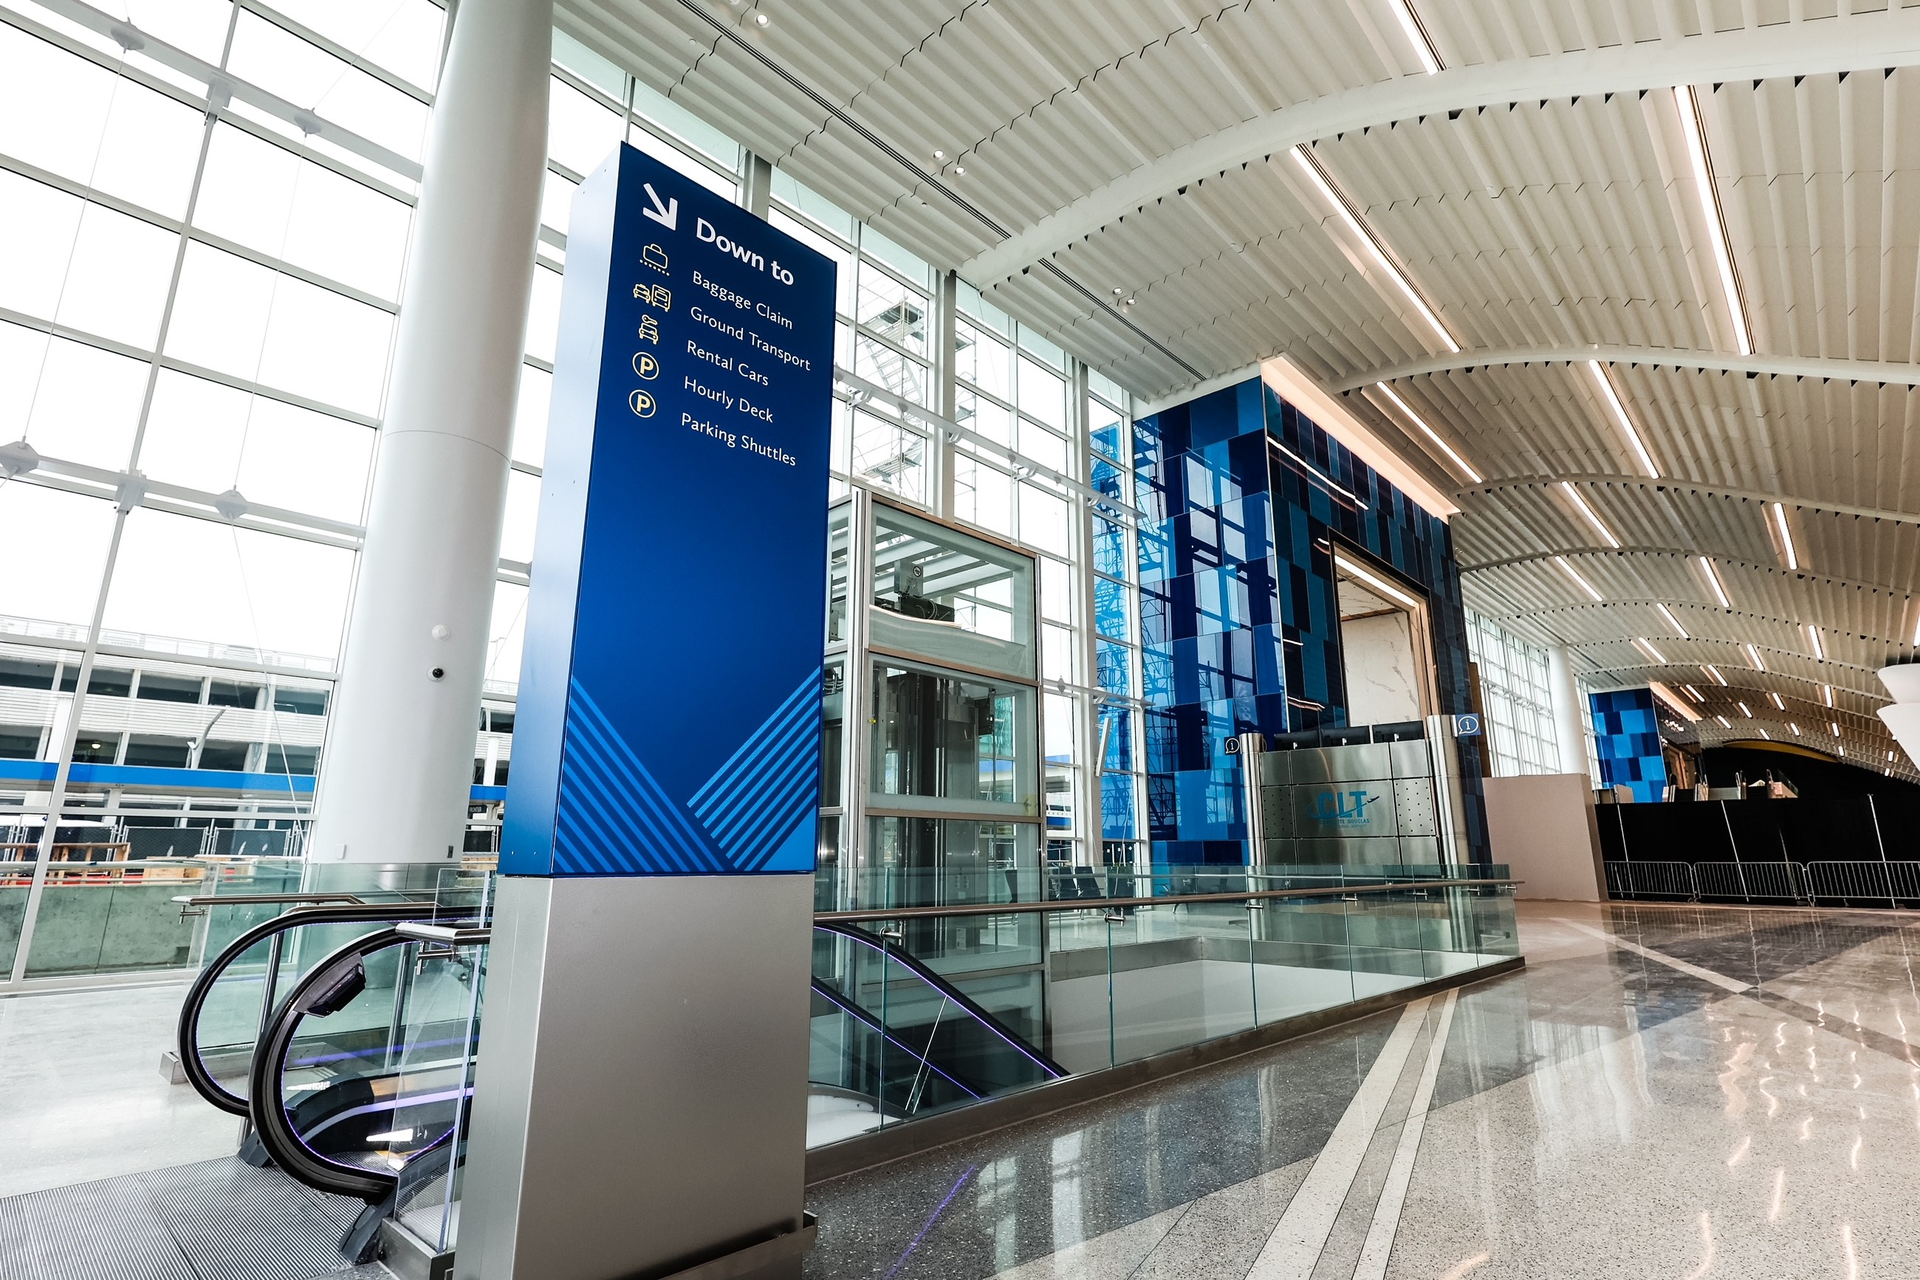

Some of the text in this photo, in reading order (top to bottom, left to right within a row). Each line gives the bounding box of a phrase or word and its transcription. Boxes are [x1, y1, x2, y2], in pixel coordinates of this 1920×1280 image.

[696, 216, 794, 286] Down to
[692, 270, 793, 330] Baggage Claim
[687, 339, 769, 386] Rental Cars
[690, 306, 811, 372] Ground Transport
[684, 375, 774, 424] Hourly Deck
[681, 412, 796, 467] Parking Shuttles
[1317, 791, 1367, 819] CLT
